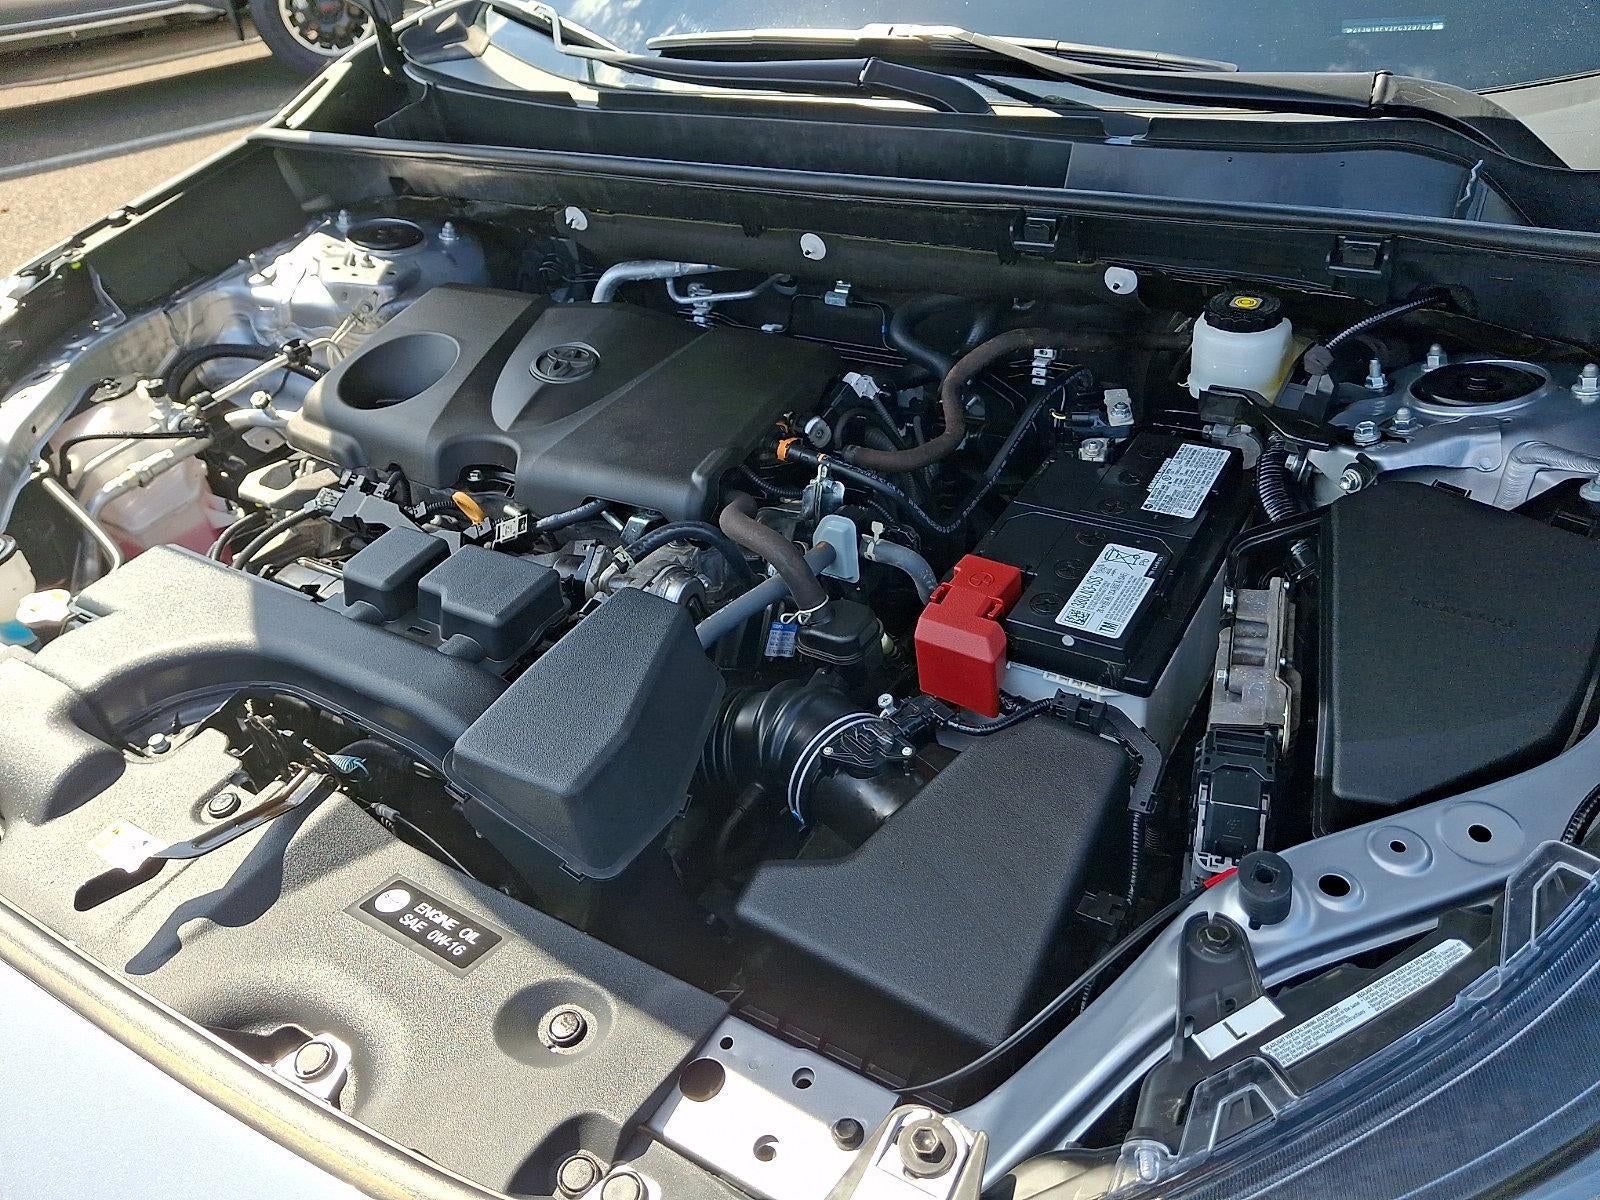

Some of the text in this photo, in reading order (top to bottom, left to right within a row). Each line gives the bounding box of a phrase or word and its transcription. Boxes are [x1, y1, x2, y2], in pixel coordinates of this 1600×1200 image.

[398, 913, 468, 956] SAE 0W-16
[413, 902, 482, 945] ENGINE OIL
[1221, 1021, 1248, 1041] L
